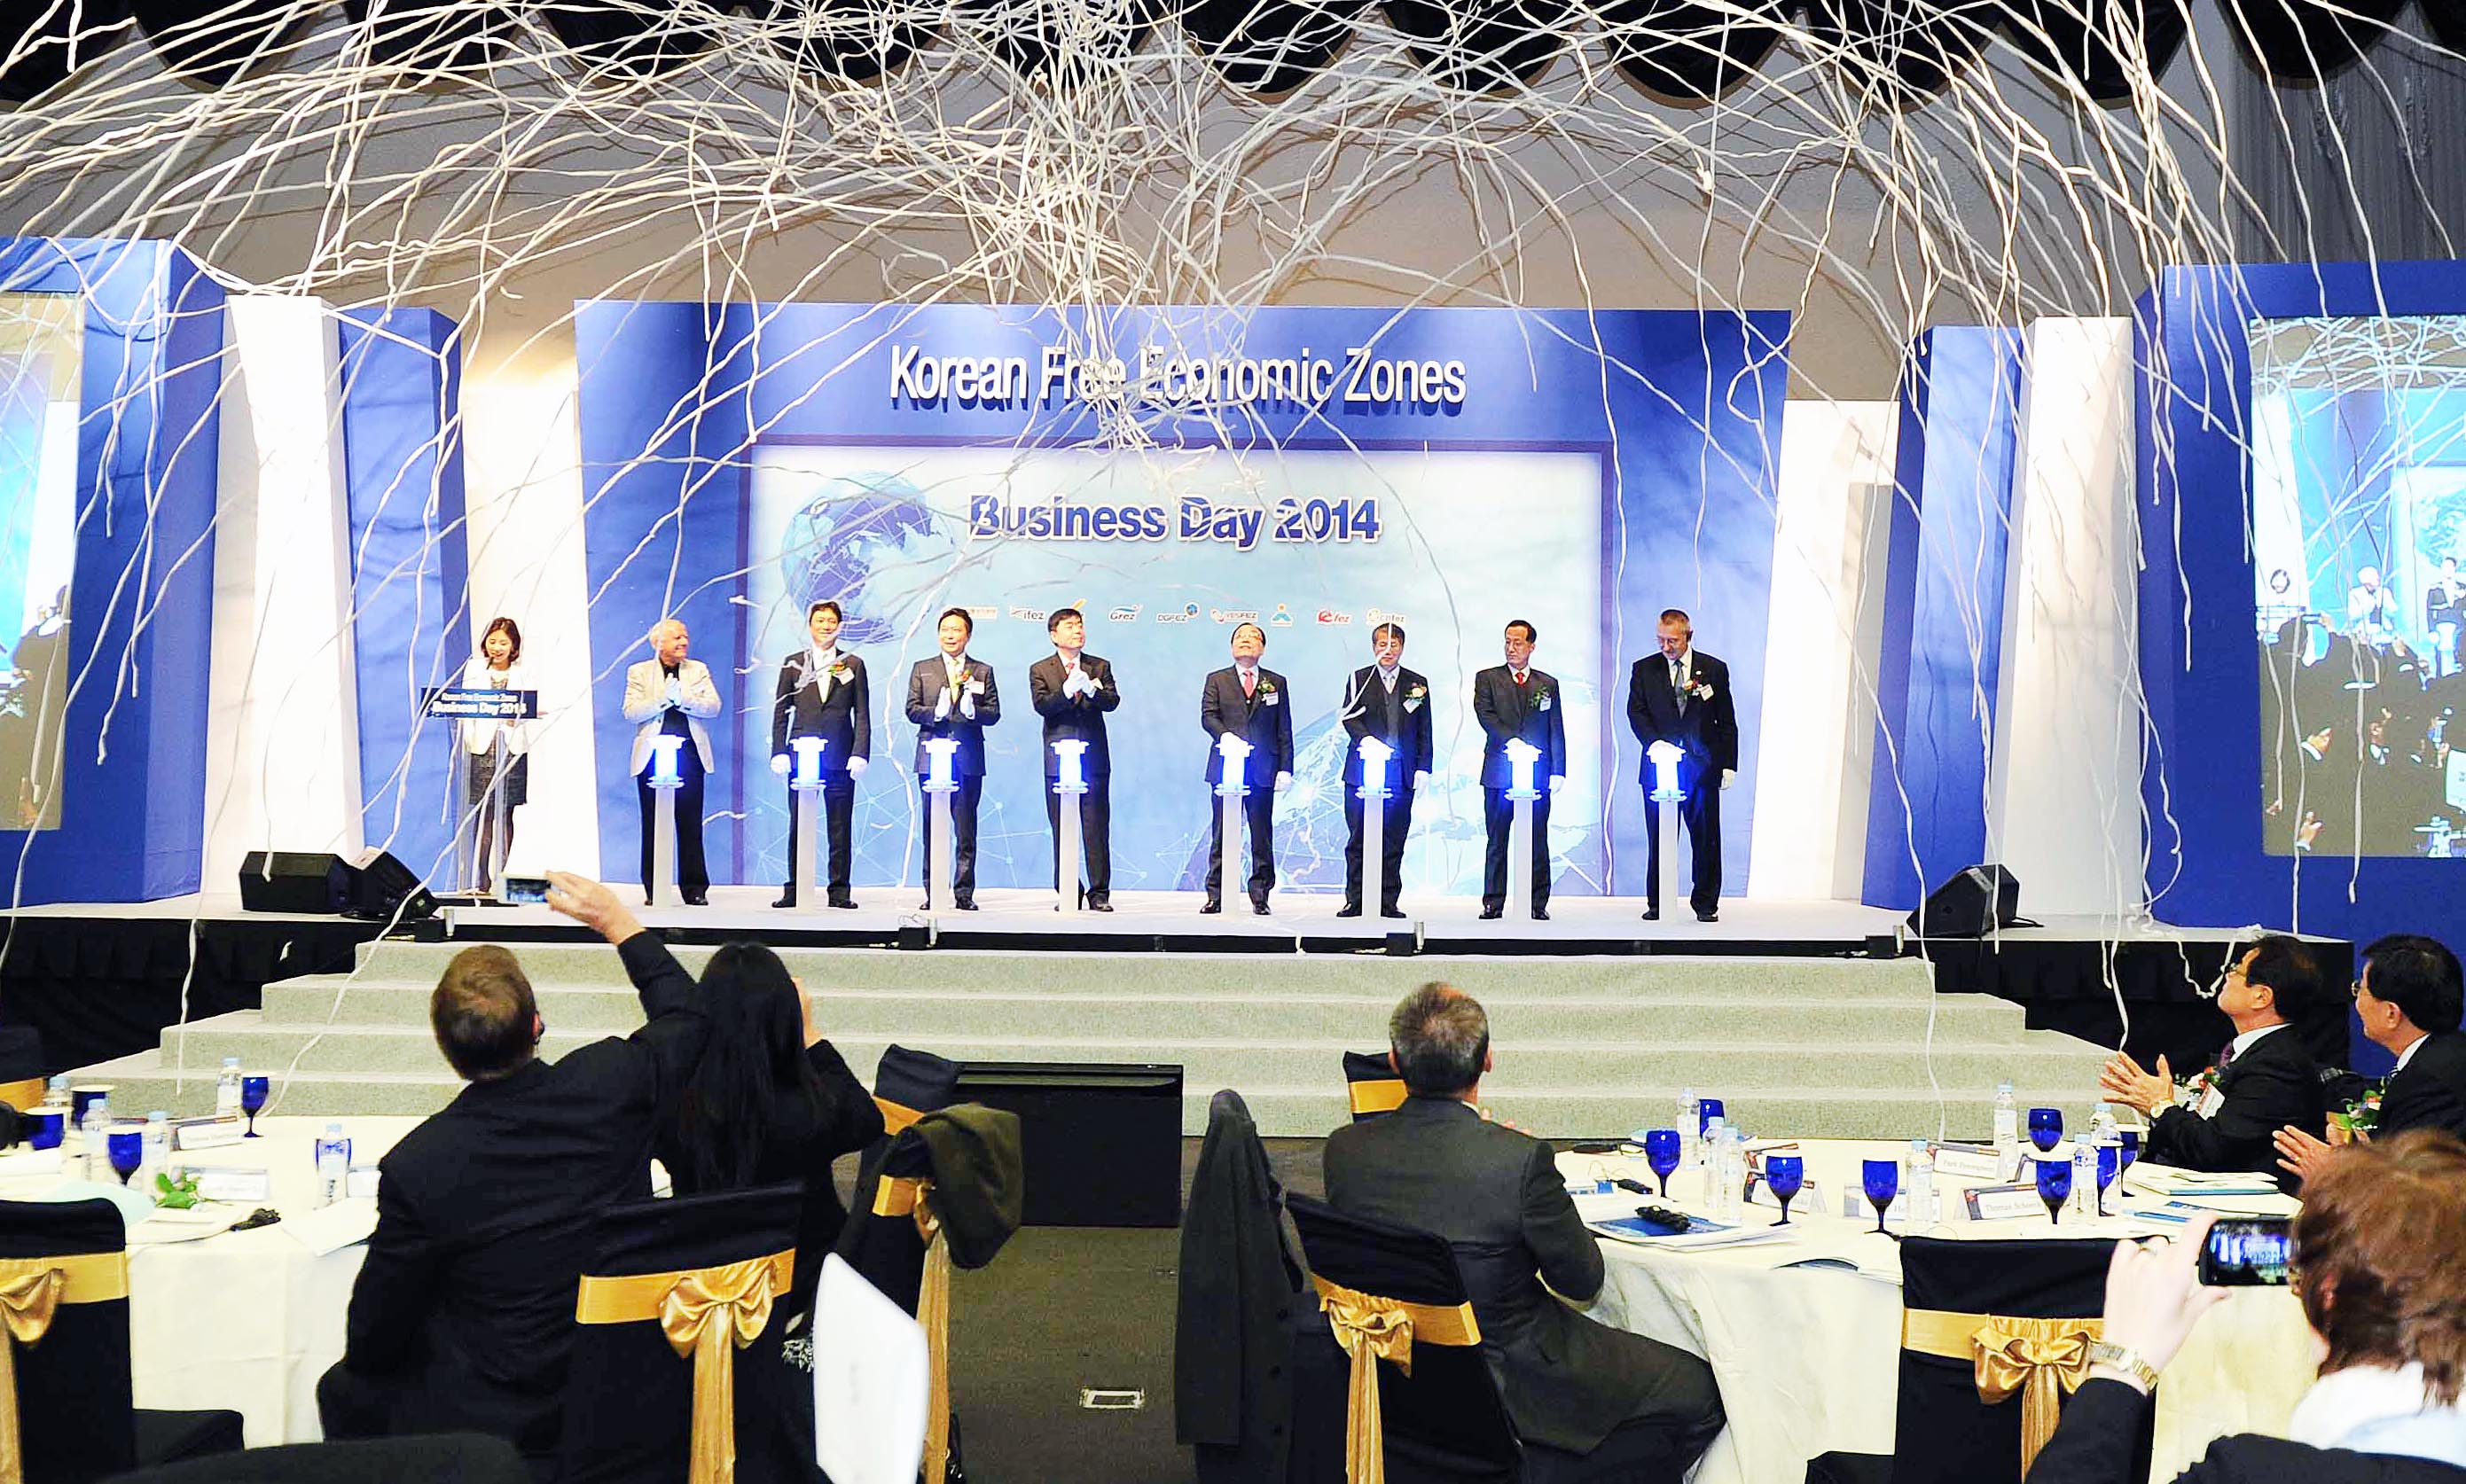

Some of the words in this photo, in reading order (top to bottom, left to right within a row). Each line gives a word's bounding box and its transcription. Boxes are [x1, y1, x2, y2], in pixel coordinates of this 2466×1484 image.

[890, 345, 1027, 401] Korean
[1040, 346, 1127, 401] Free
[1139, 347, 1333, 402] Economic
[1344, 348, 1467, 403] Zones
[970, 495, 1167, 541] Business
[1178, 496, 1264, 551] Day
[1273, 497, 1381, 543] 2014
